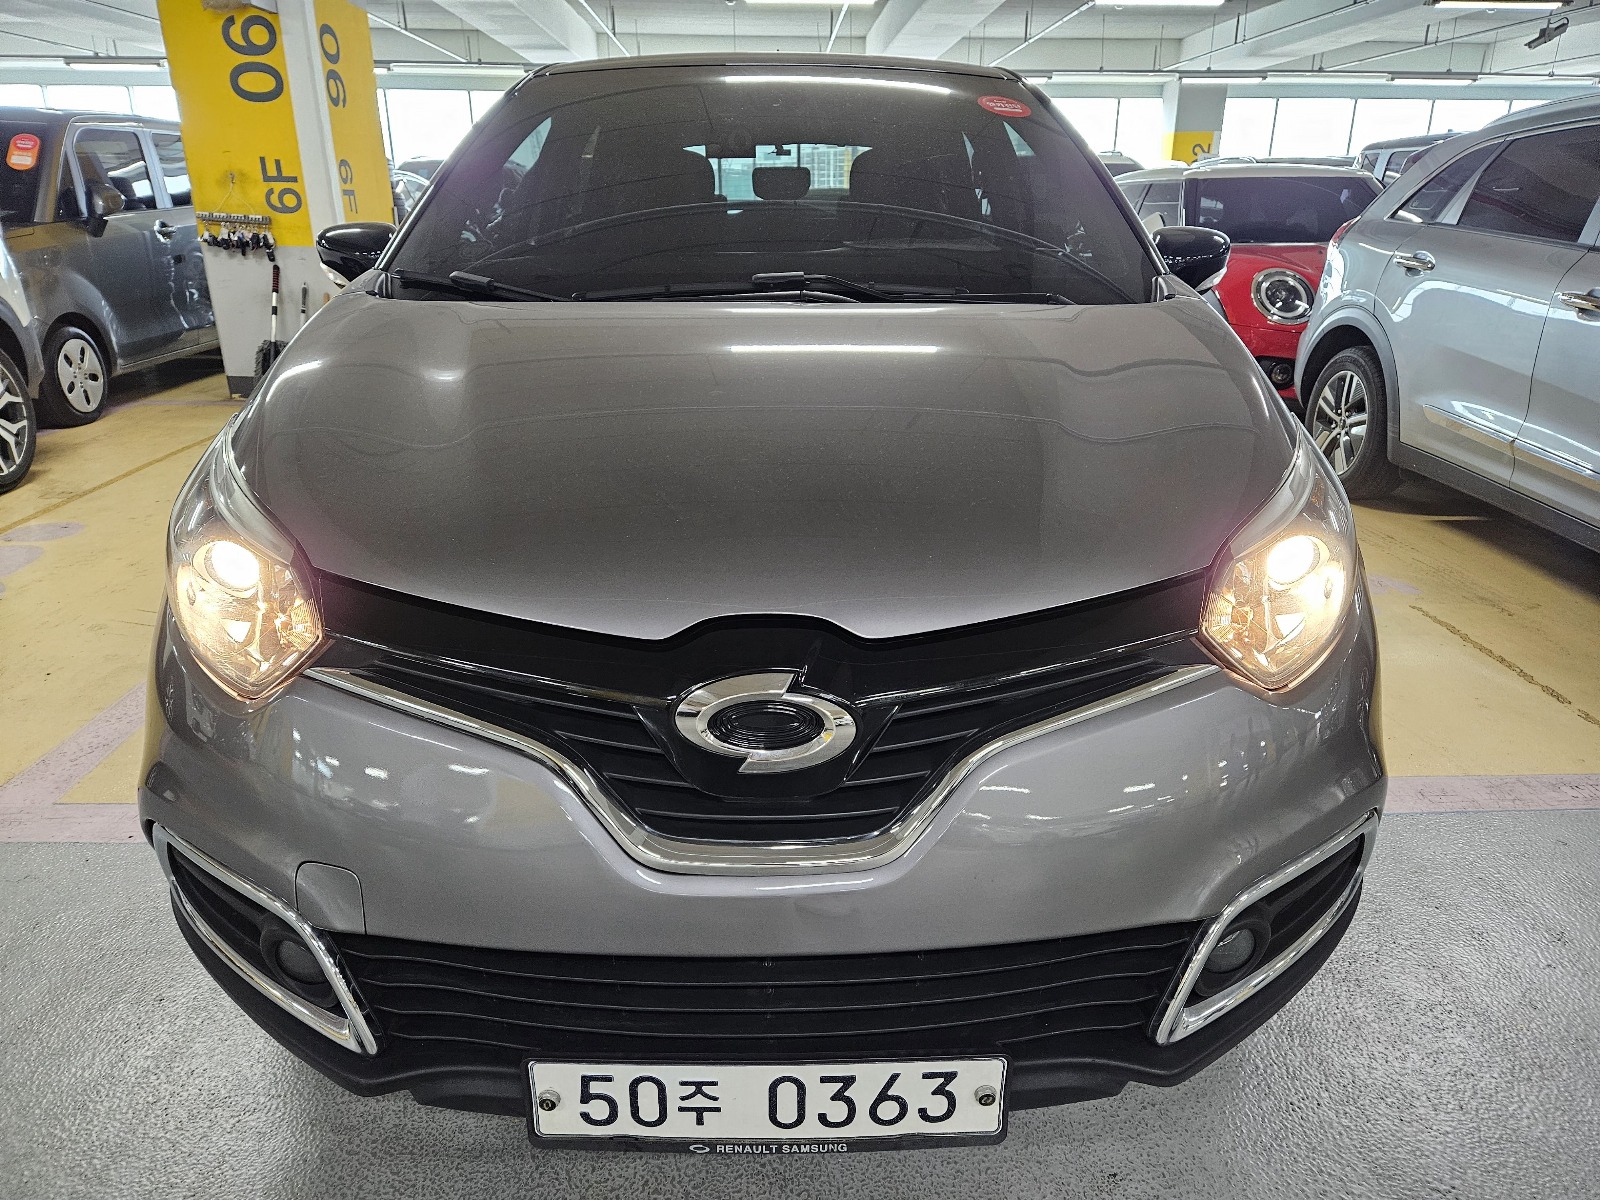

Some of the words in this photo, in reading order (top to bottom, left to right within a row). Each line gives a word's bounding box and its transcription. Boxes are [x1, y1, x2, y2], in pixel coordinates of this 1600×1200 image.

[221, 14, 284, 103] 06
[319, 23, 347, 108] 06
[259, 156, 303, 214] 6F
[338, 158, 358, 214] 6F
[579, 1074, 721, 1127] 50주
[766, 1070, 958, 1129] 0363
[716, 1144, 778, 1154] RENAULT
[781, 1143, 848, 1153] SAMSUNG
